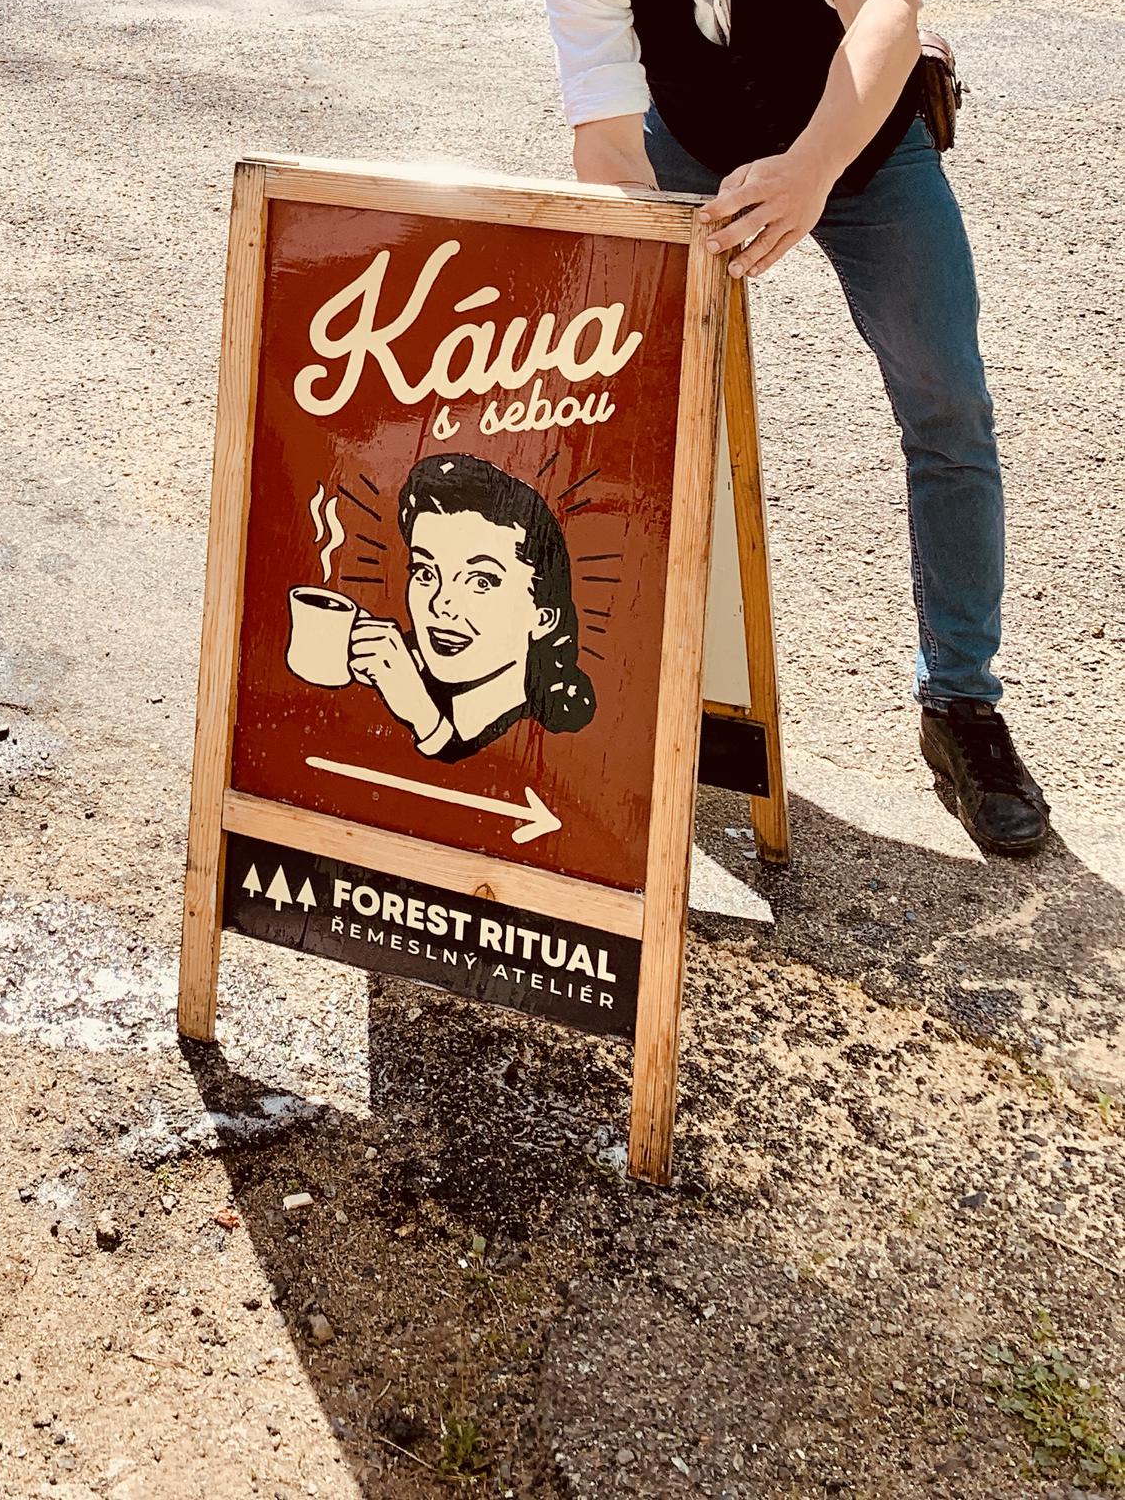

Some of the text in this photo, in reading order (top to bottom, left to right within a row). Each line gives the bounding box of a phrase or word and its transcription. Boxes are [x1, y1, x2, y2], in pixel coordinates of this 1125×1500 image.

[293, 239, 643, 417] Káva
[432, 377, 616, 441] s sebou
[330, 916, 615, 1010] ŘEMESLNÝ ATELIÉR
[332, 879, 617, 983] FOREST RITUAL
